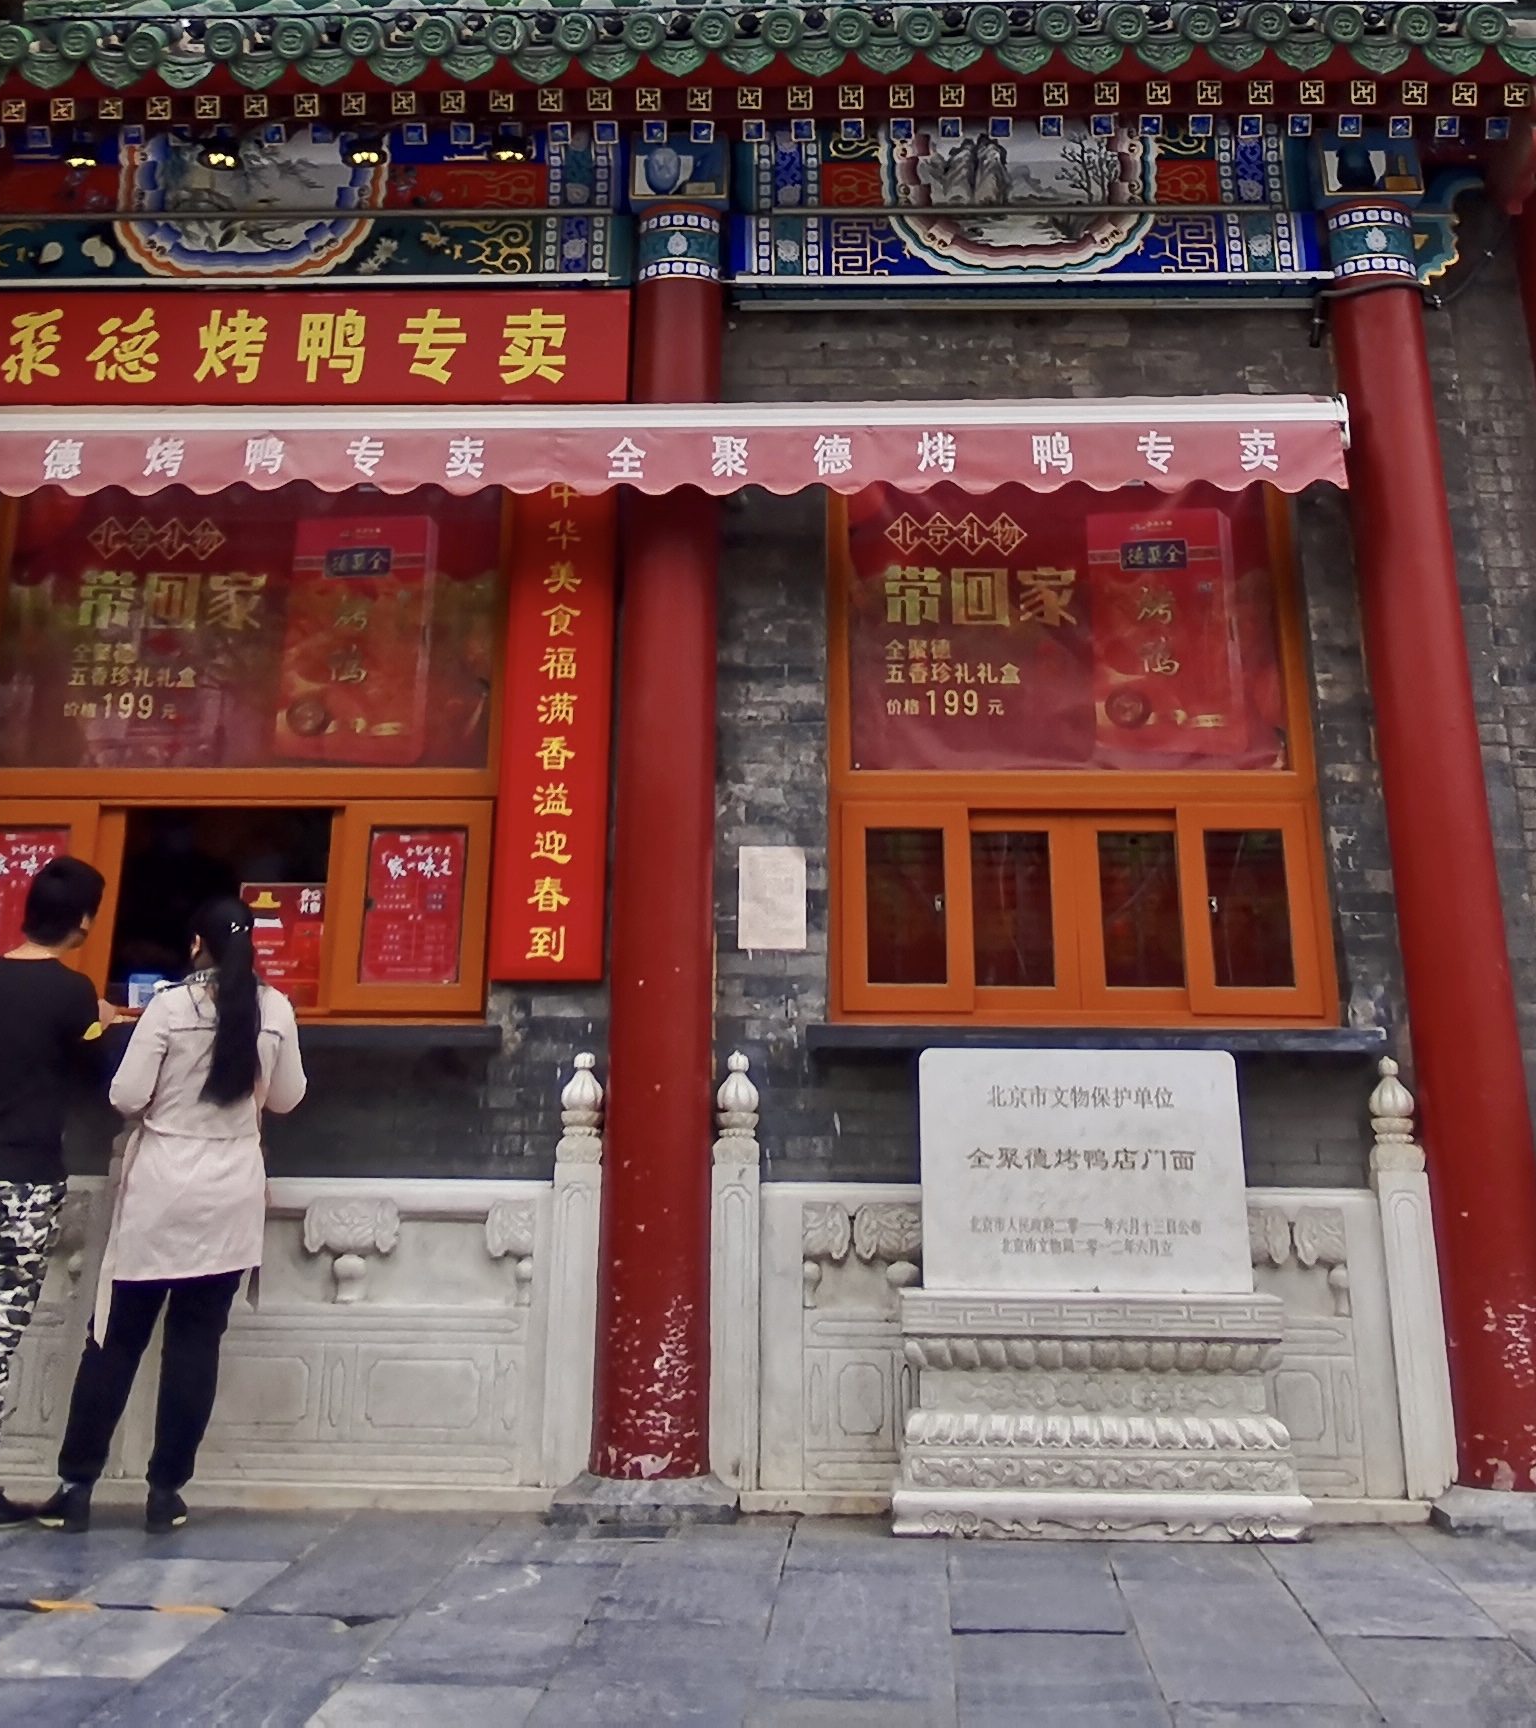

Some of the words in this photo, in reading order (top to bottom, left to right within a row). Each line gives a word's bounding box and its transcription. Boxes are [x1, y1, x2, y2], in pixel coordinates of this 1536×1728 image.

[606, 429, 1282, 480] 全聚德烤鸭专卖
[893, 518, 1020, 551] 北京礼物
[77, 570, 268, 631] 带回家
[883, 566, 1079, 627] 带回家
[884, 638, 953, 661] 全聚德
[525, 482, 582, 964] 中华美食福满香溢迎春到
[985, 1084, 1176, 1111] 北京市文物保护单位
[967, 1146, 1198, 1173] 全聚德烤鸭店门面
